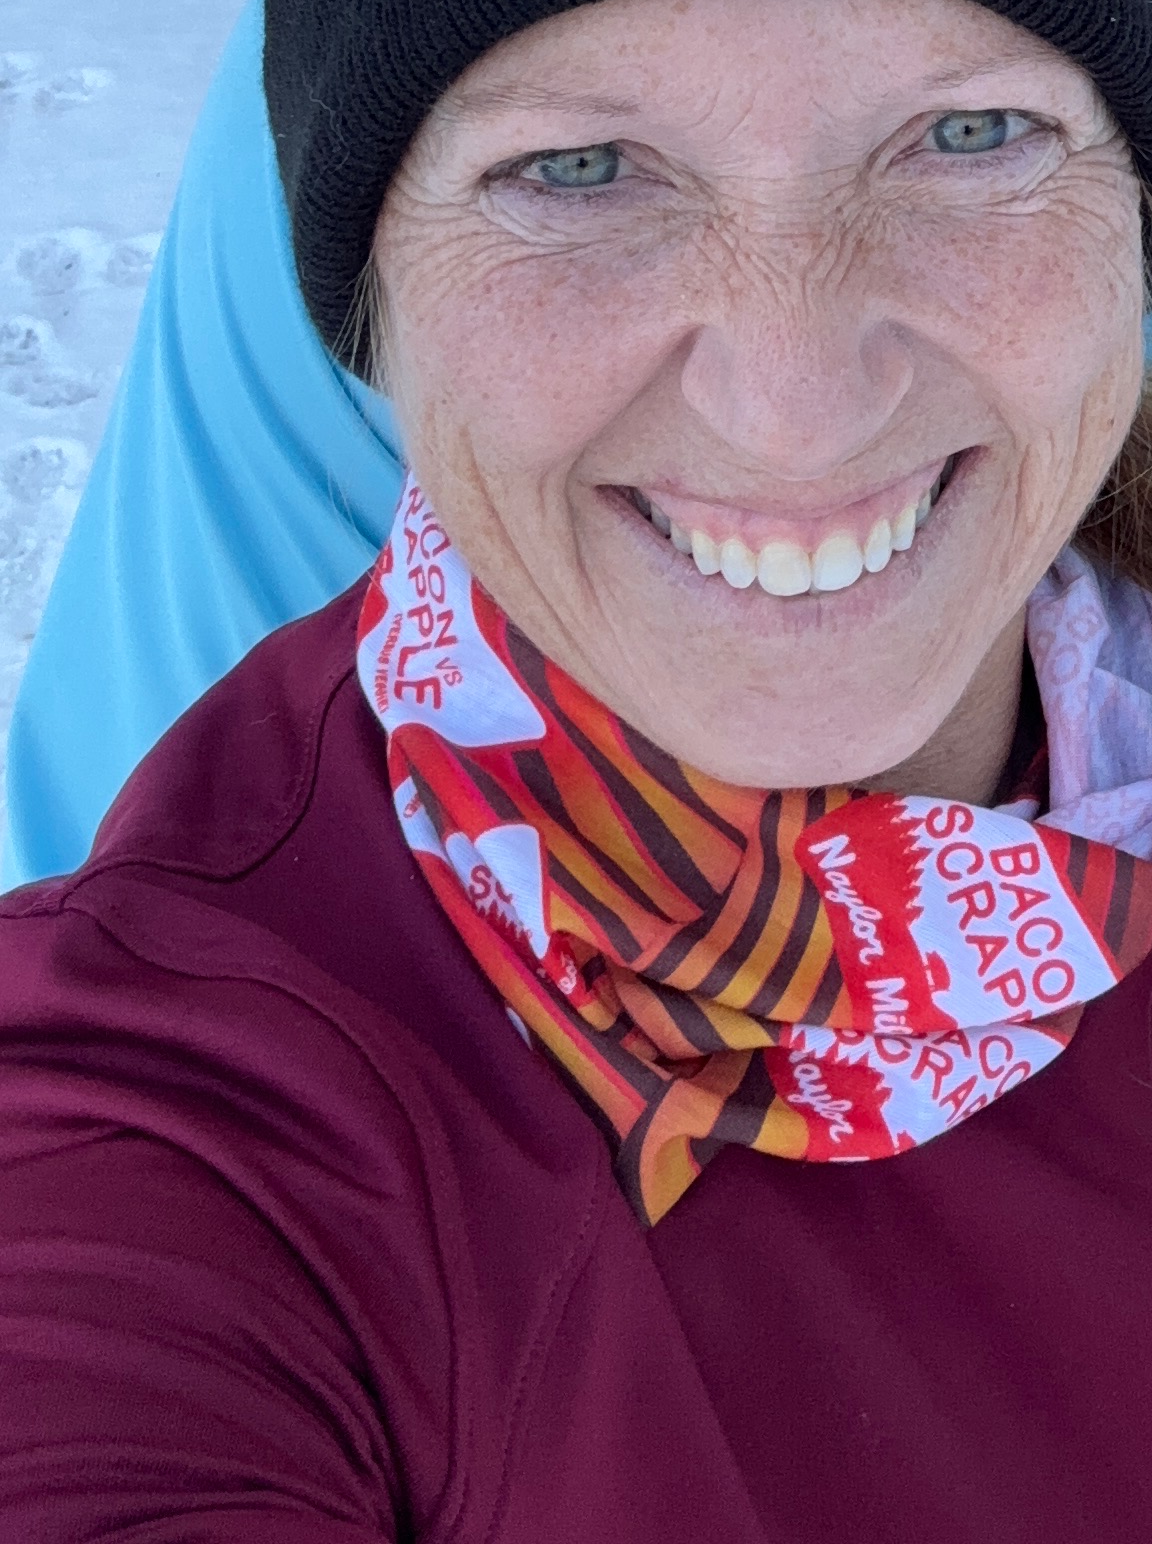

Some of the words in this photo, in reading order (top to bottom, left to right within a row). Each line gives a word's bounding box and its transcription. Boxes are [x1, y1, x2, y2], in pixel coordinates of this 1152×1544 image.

[420, 511, 459, 649] CON
[808, 833, 884, 966] Naylor
[925, 803, 1033, 1025] SCRAP
[990, 842, 1075, 1003] BACO
